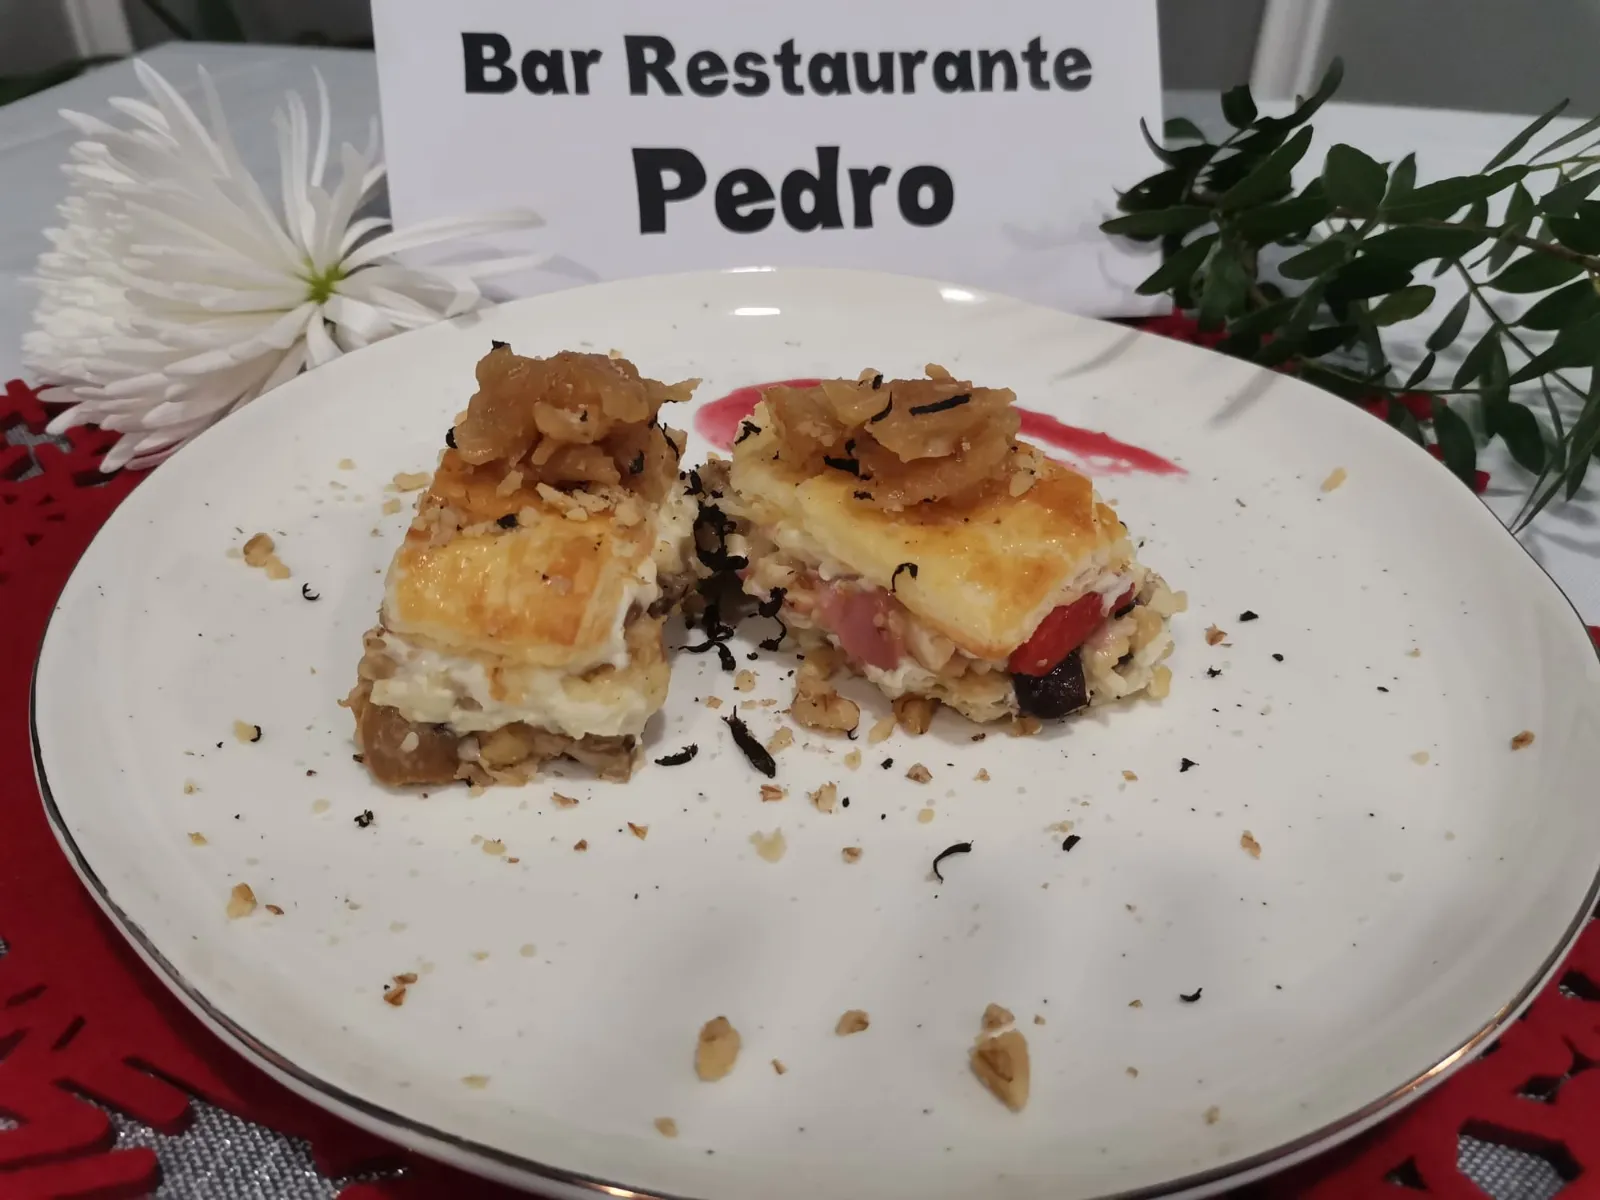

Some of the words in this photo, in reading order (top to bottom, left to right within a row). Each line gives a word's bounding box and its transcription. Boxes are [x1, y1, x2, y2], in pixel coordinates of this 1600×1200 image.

[461, 32, 603, 95] Bar
[624, 35, 1093, 97] Restaurante
[631, 146, 955, 234] Pedro
